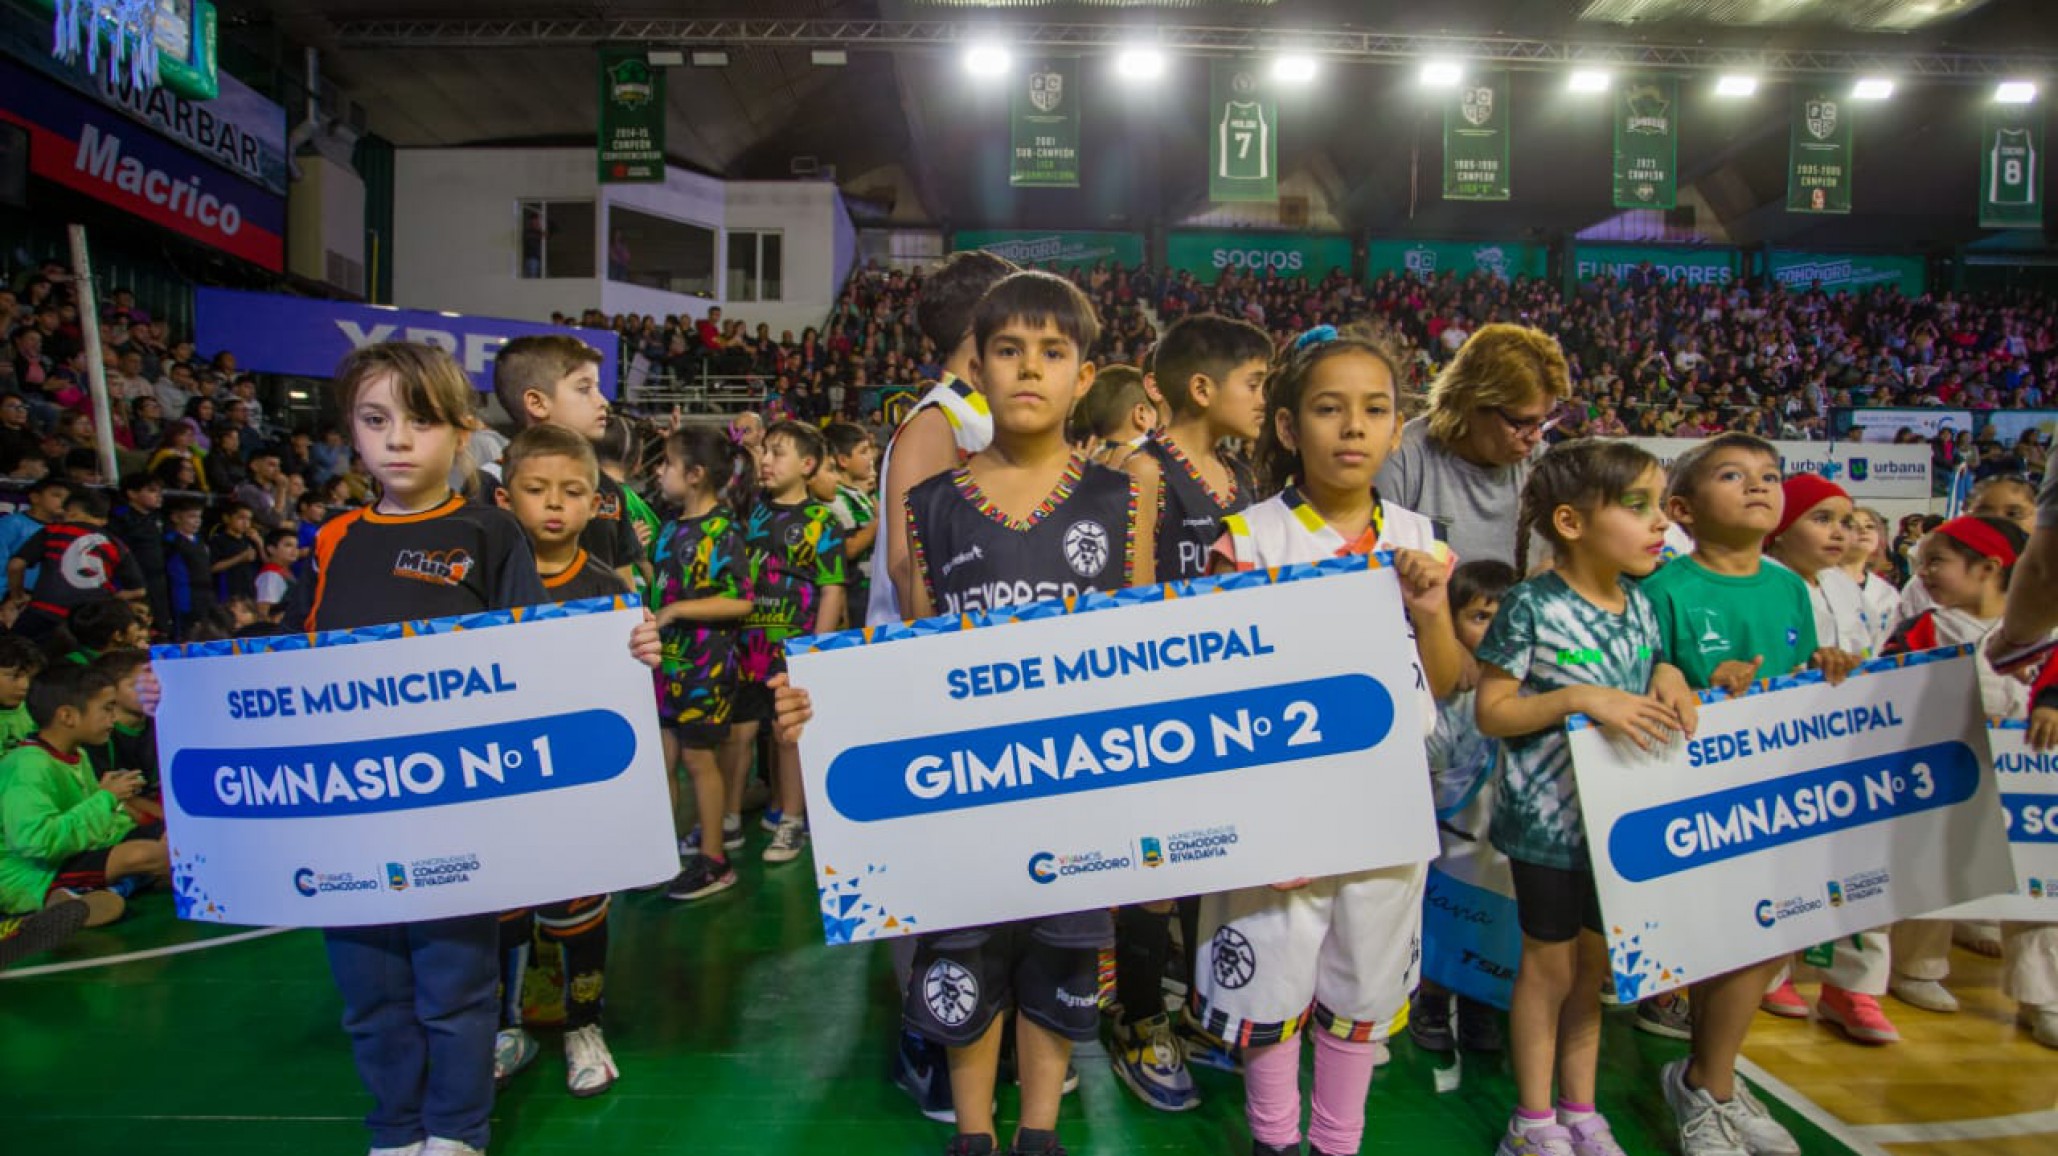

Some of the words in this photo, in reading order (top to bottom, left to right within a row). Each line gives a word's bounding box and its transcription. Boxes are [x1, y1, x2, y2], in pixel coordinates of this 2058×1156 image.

[1234, 132, 1252, 158] 7
[74, 123, 241, 235] Macrico
[2004, 160, 2021, 185] 8
[1212, 247, 1304, 270] SOCIOS
[1873, 460, 1925, 473] urbana
[61, 533, 111, 590] 6
[947, 657, 1045, 699] SEDE
[1054, 625, 1275, 685] MUNICIPAL
[228, 687, 296, 719] SEDE
[302, 662, 517, 714] MUNICIPAL
[1687, 729, 1752, 768] SEDE
[1757, 701, 1903, 752] MUNICIPAL
[904, 719, 1196, 800] GIMNASIO
[1283, 700, 1323, 747] 2
[214, 751, 446, 806] GIMNASIO
[532, 734, 554, 777] 1
[1664, 780, 1857, 858] GIMNASIO
[1911, 762, 1935, 798] 3
[1168, 833, 1239, 852] COMODORO
[1060, 857, 1130, 876] COMODORO
[1169, 847, 1228, 864] RIVADAVIA
[412, 860, 481, 877] COMODORO
[413, 873, 470, 888] RIVADAVIA
[319, 879, 379, 892] COMODORO
